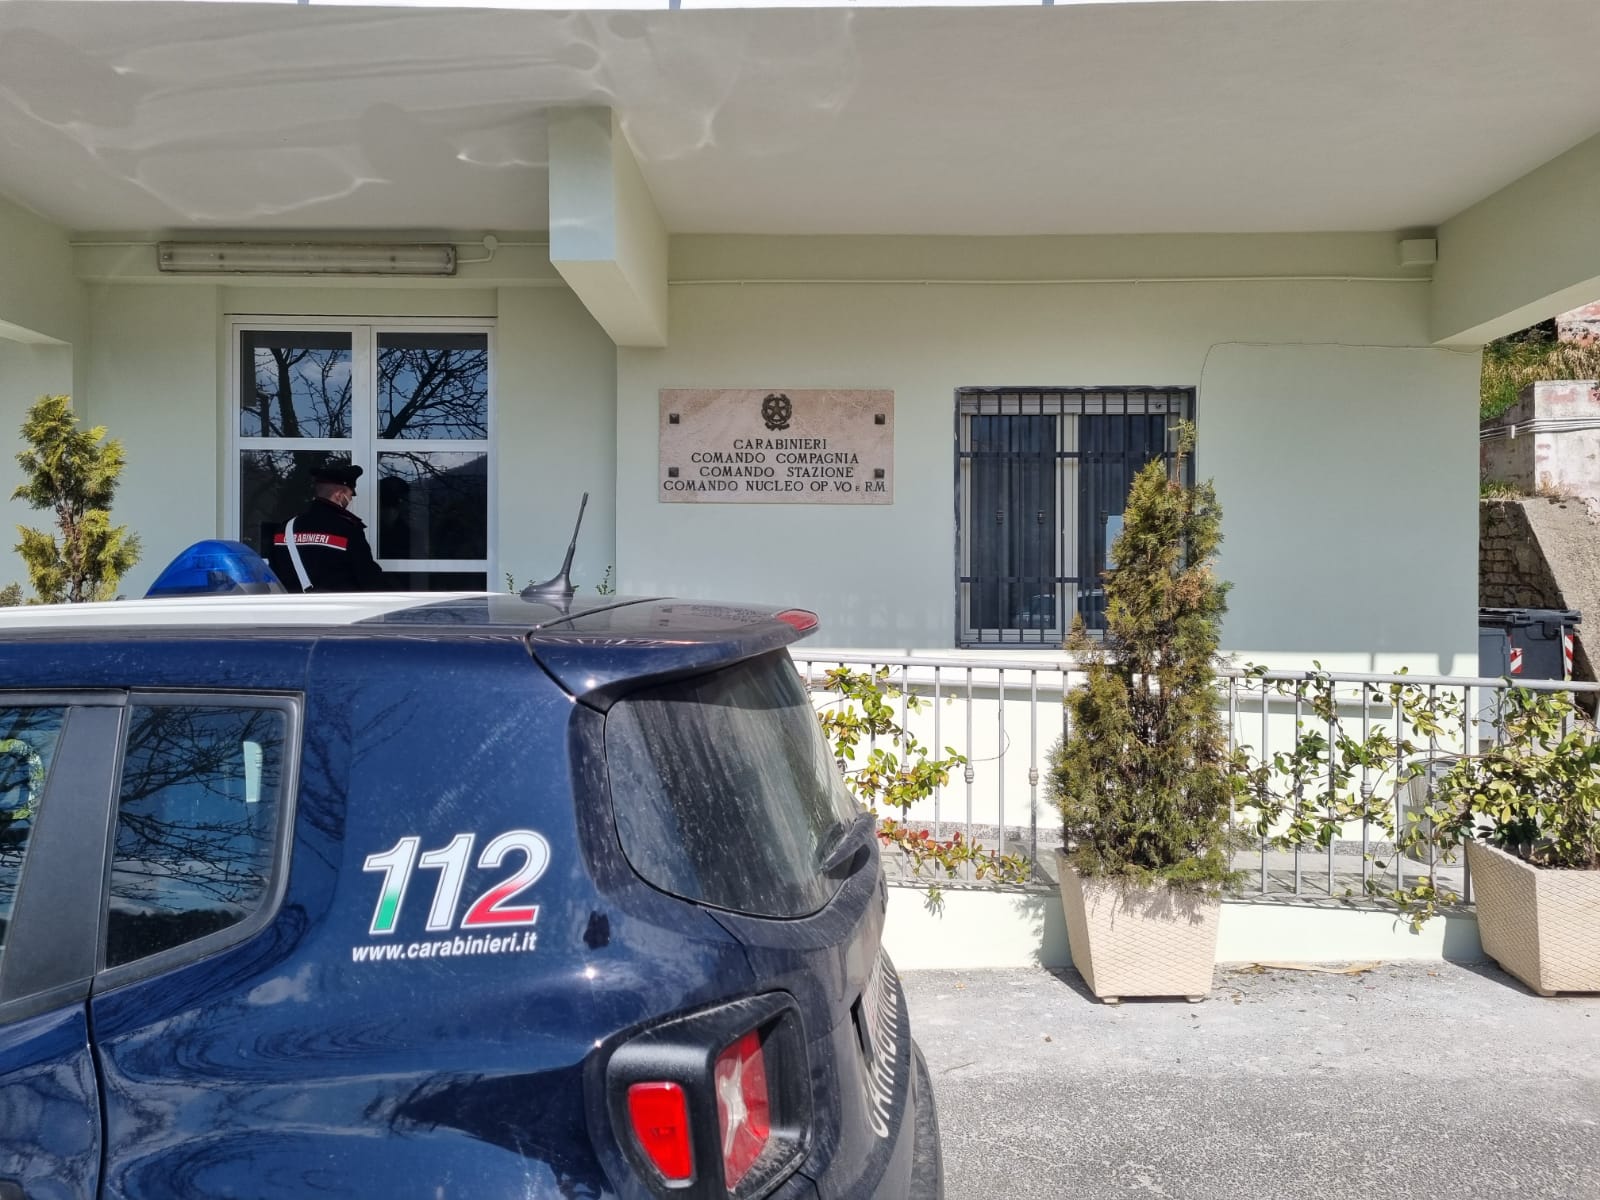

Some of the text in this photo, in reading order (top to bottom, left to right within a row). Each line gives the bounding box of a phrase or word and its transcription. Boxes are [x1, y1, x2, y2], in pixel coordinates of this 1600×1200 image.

[733, 438, 828, 450] CARABINIERI
[691, 452, 859, 464] COMANDO COMPAGNIA
[699, 466, 854, 478] COMANDO STAZIONE
[663, 480, 738, 492] COMANDO
[745, 480, 804, 492] NUCLEO
[283, 533, 330, 543] RABINIERI
[363, 829, 551, 935] 112
[352, 932, 538, 962] www.carabinieri.it
